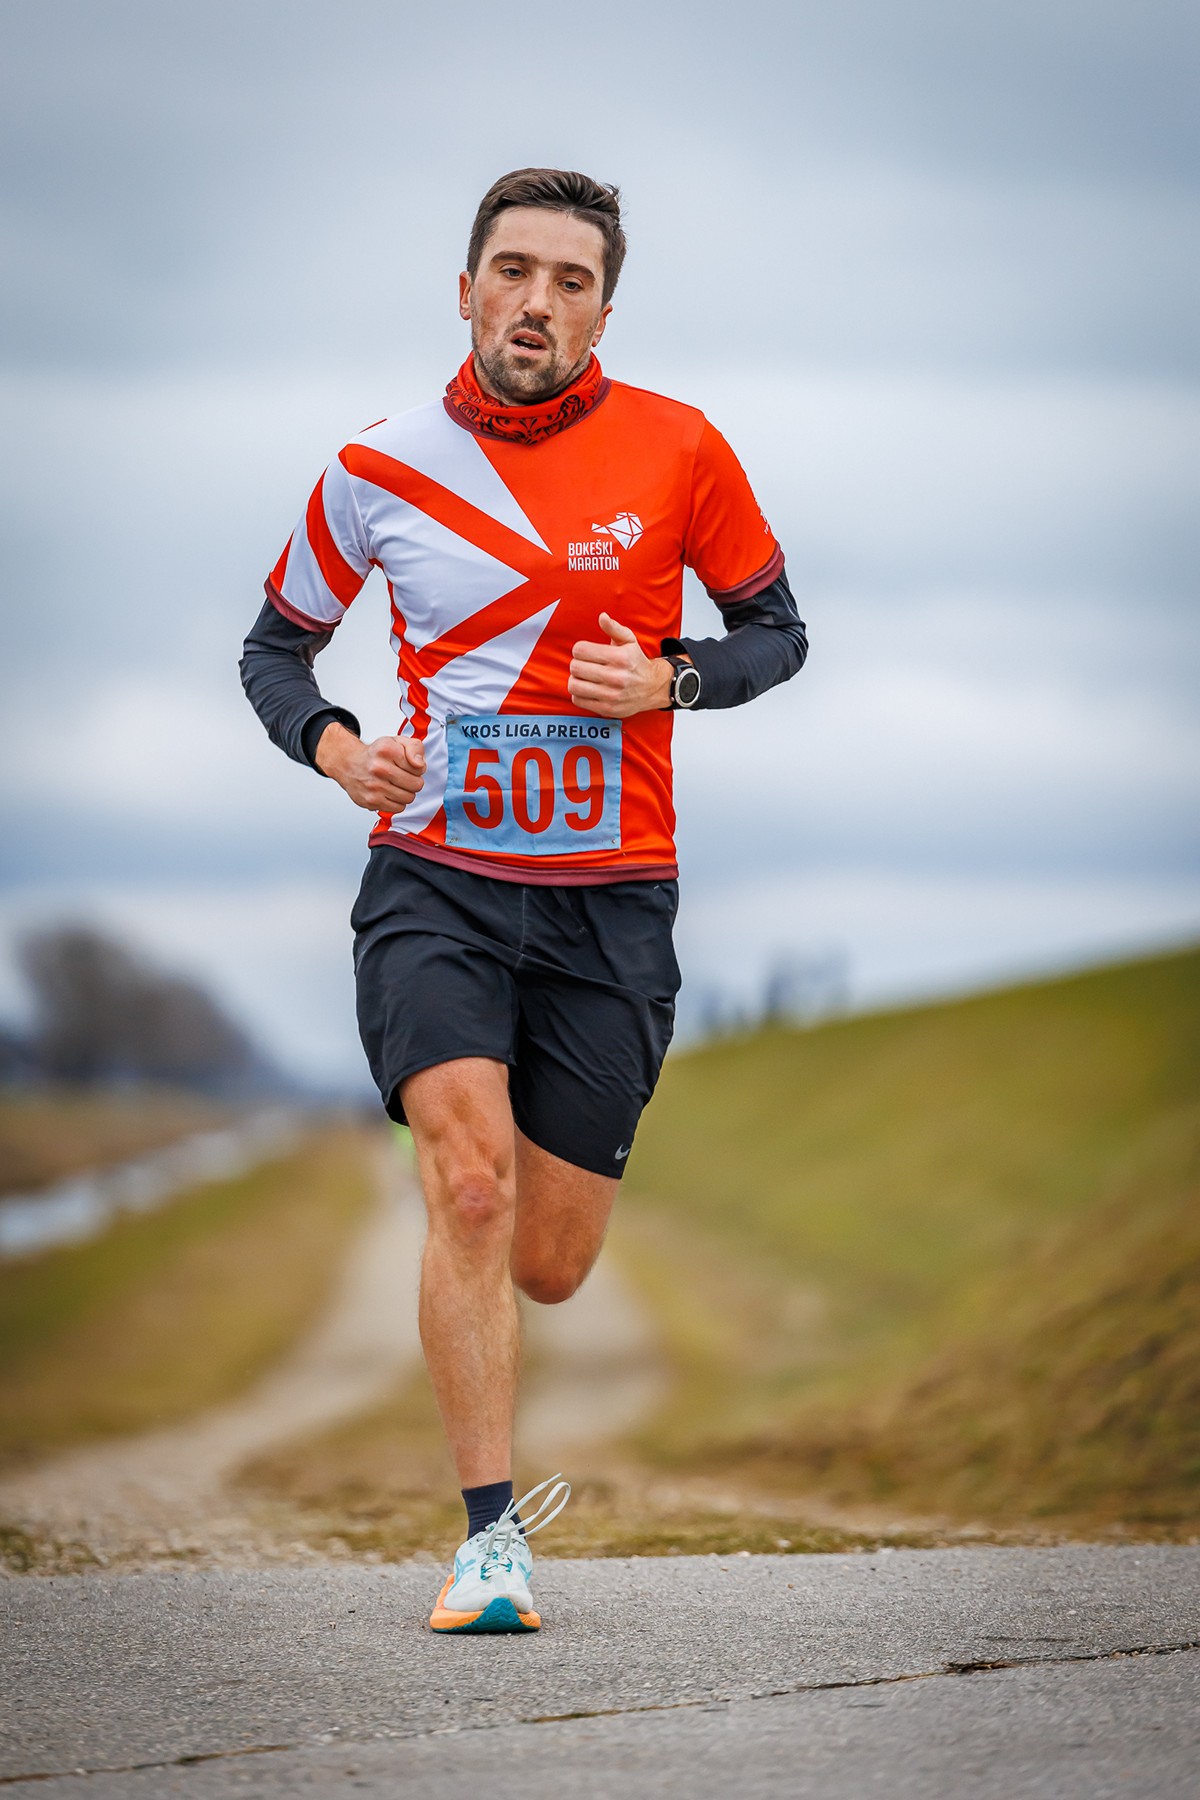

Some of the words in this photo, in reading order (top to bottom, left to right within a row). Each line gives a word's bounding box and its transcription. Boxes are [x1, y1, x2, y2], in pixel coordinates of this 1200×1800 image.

[568, 539, 613, 556] BOKEŠKI
[568, 556, 619, 571] MARATON
[461, 725, 501, 738] KROS
[505, 724, 542, 737] LIGA
[546, 725, 610, 739] PRELOG
[462, 745, 605, 834] 509
